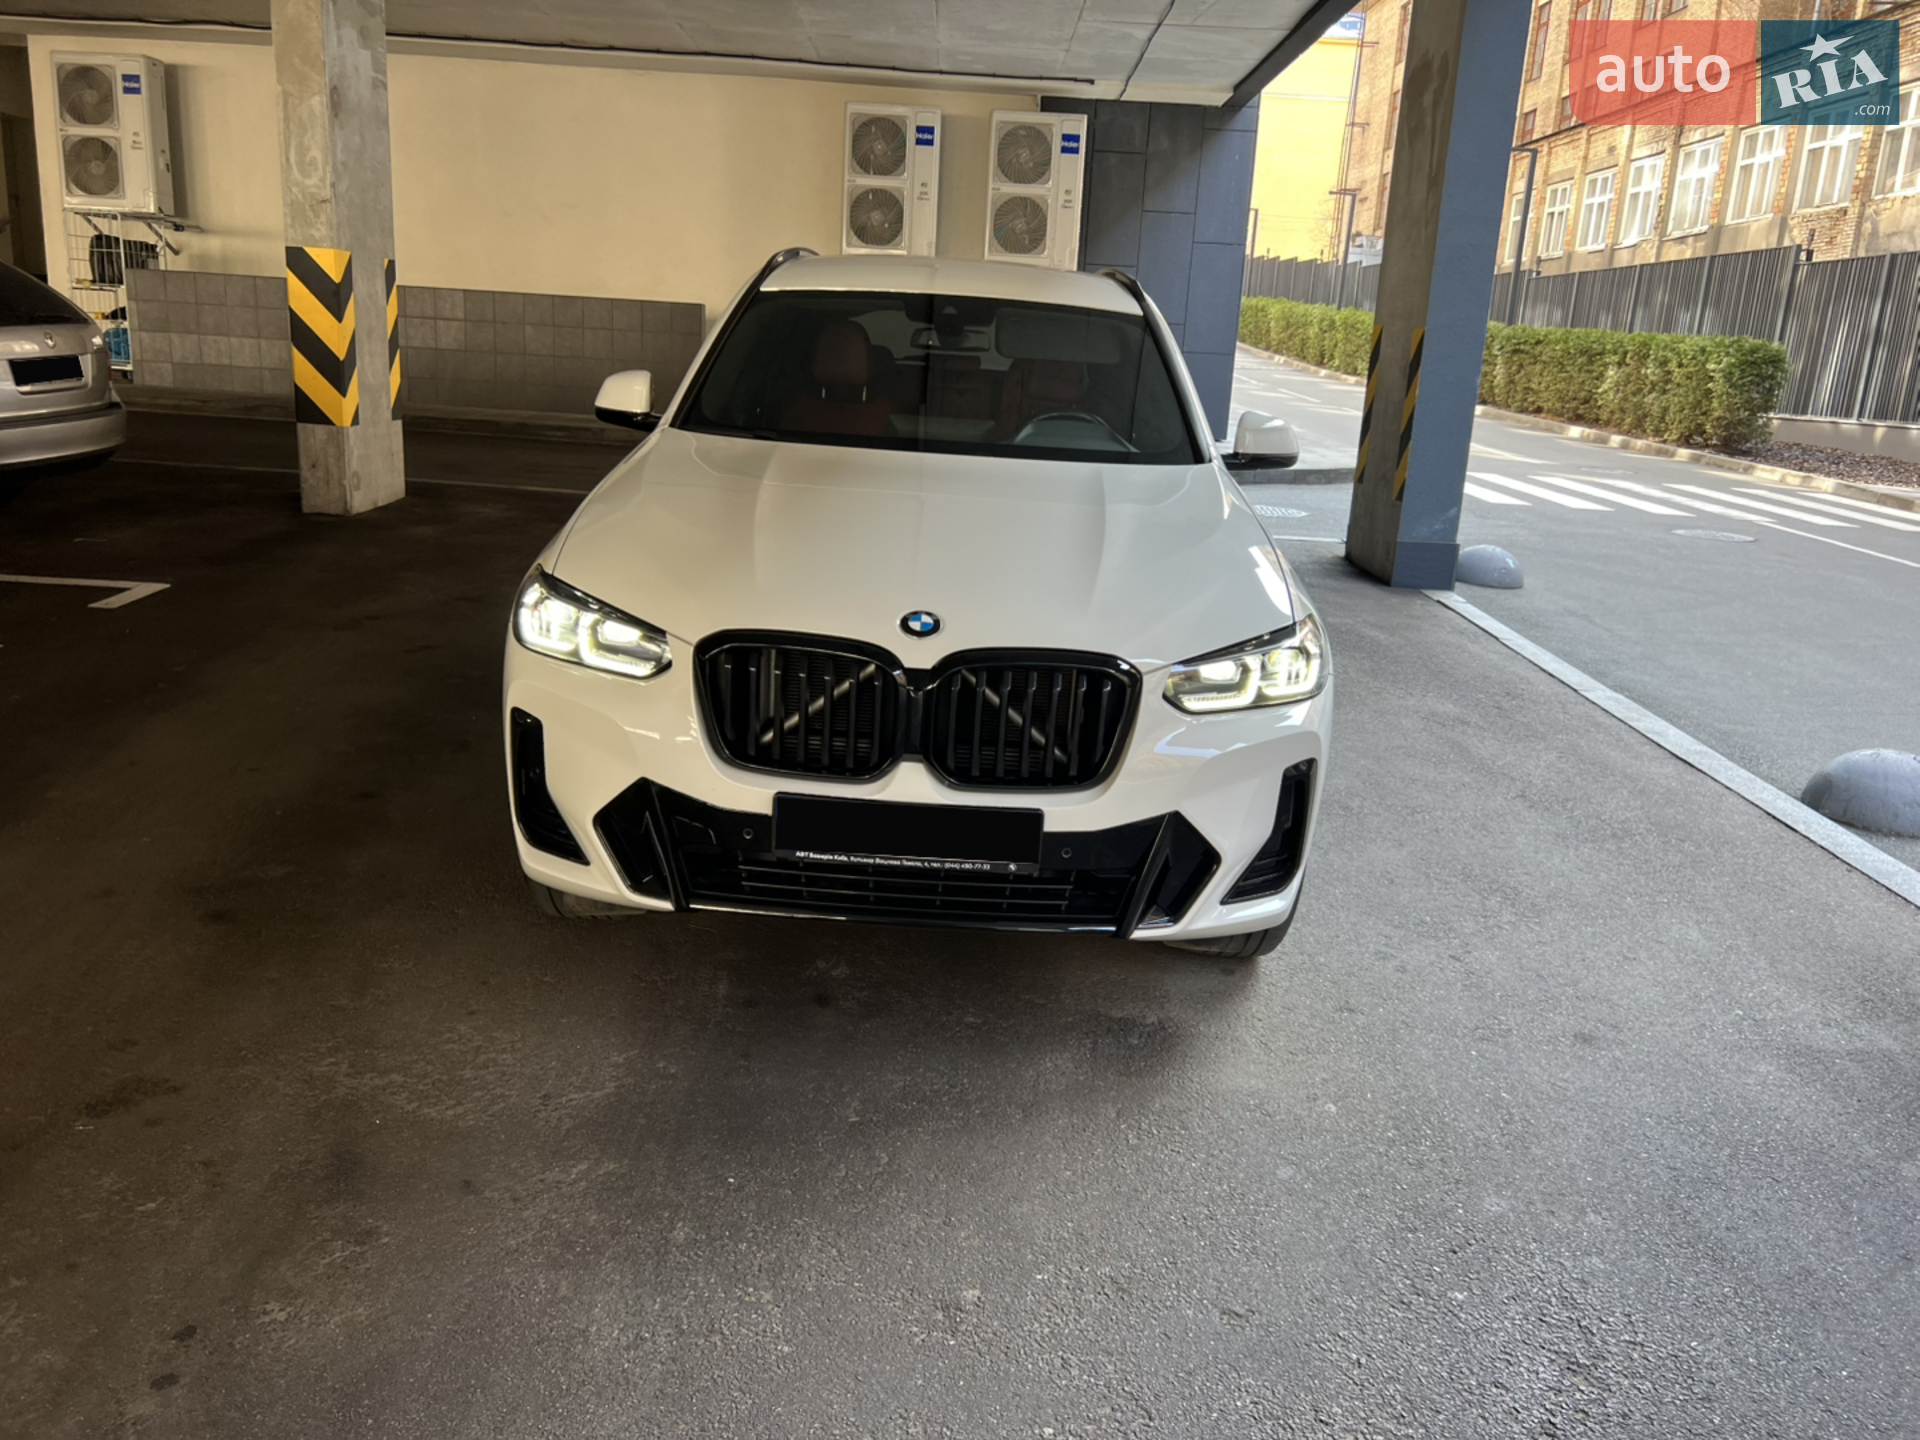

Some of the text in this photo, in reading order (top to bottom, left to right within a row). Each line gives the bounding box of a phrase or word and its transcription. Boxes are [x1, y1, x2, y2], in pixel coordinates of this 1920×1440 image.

[122, 80, 140, 89] Haier
[915, 131, 934, 140] Haier
[1061, 140, 1079, 148] Haier
